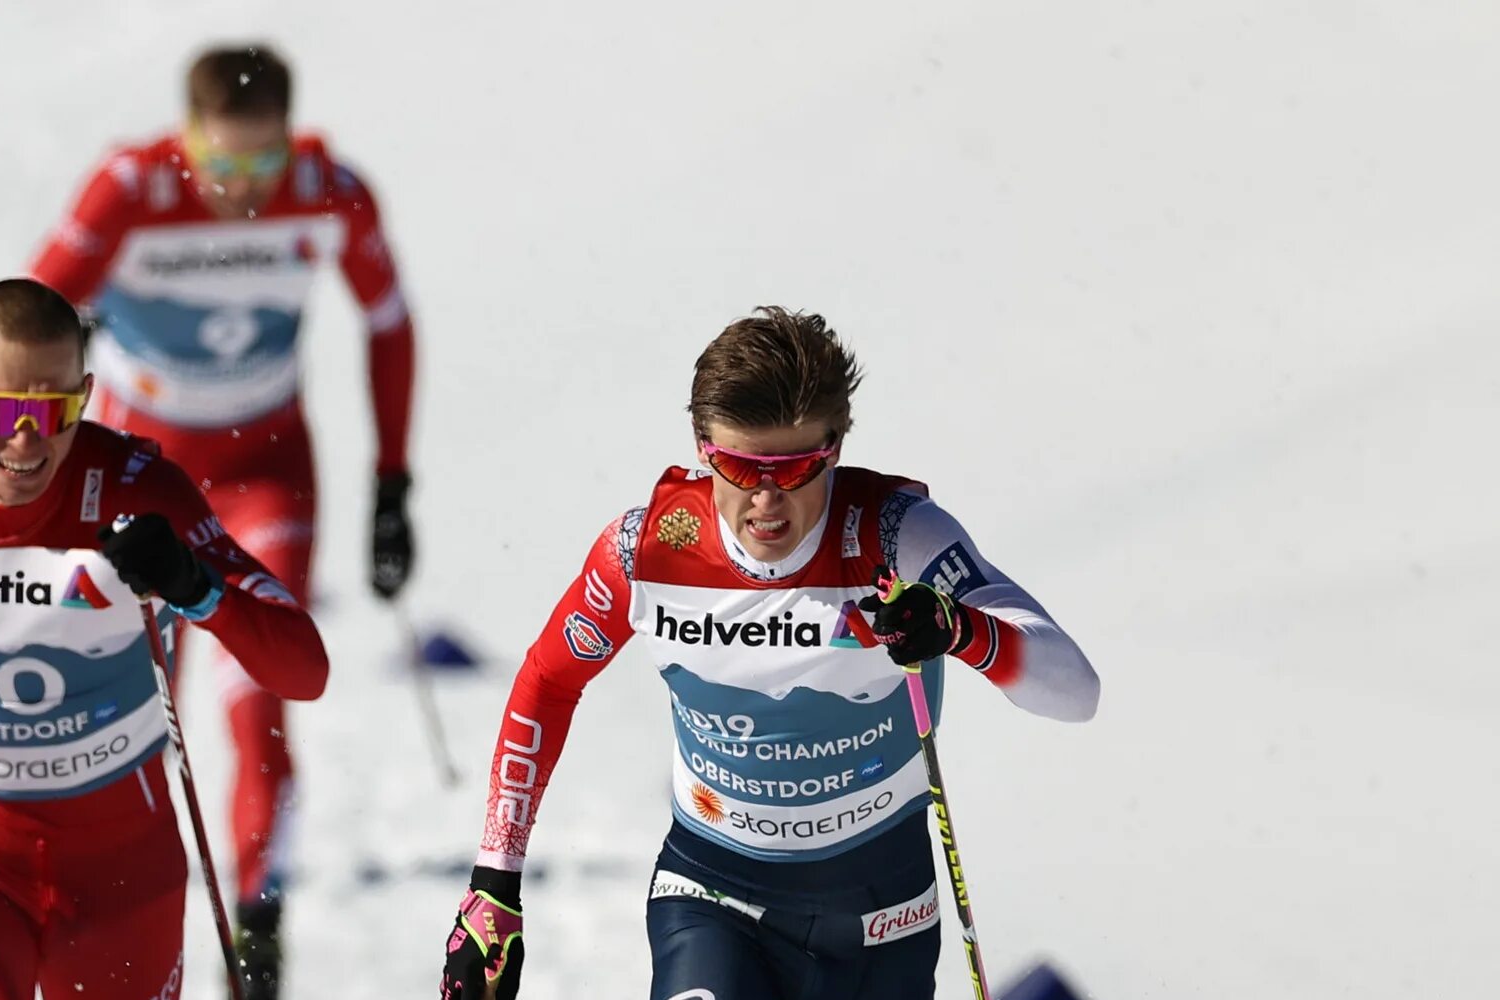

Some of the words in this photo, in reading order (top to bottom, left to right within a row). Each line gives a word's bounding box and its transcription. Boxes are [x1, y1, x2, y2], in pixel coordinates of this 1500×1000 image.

[655, 605, 821, 647] helvetia
[684, 707, 755, 741] 019
[686, 723, 748, 758] ORLD
[755, 717, 893, 760] CHAMPION
[691, 752, 855, 798] OBERSTDORF
[483, 911, 500, 944] EKI
